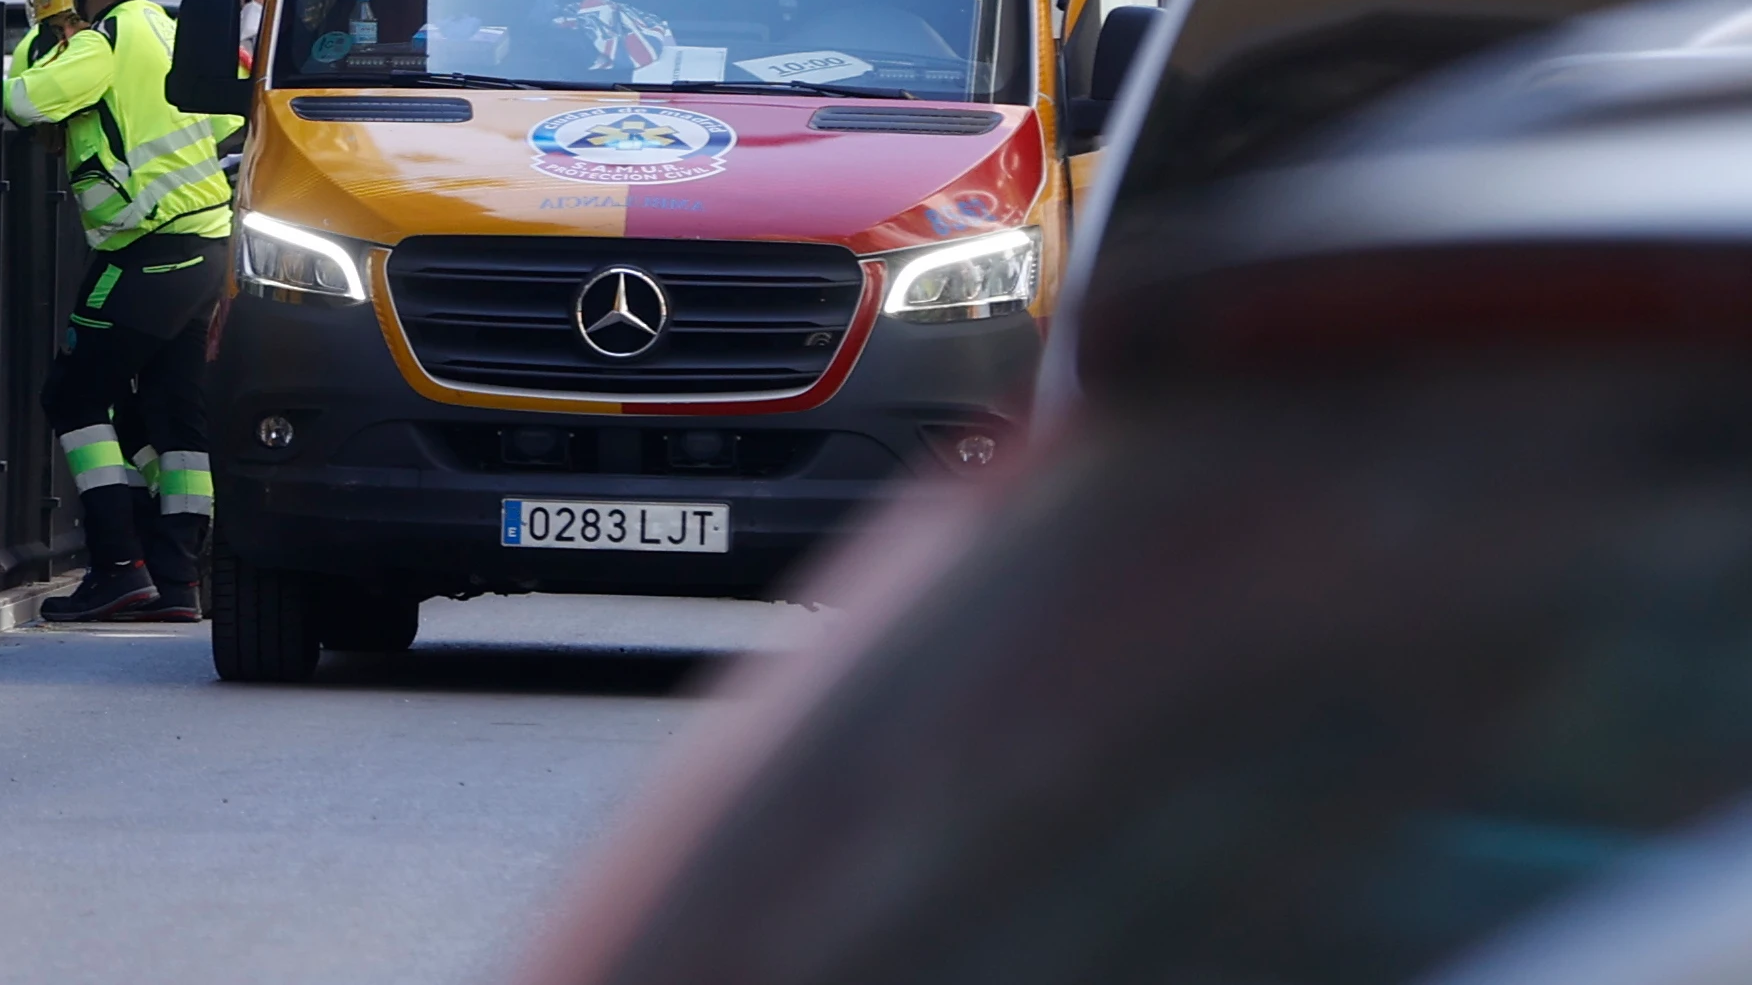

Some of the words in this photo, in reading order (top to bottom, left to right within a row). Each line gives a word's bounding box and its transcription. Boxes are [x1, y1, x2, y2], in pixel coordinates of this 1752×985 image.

[768, 56, 845, 76] 10:00
[543, 107, 607, 131] ciudad
[617, 106, 648, 115] de
[660, 109, 728, 134] madrid
[544, 163, 658, 182] PROTECCION
[664, 165, 710, 180] CIVIL
[571, 162, 684, 175] S.A.M.U.R.
[508, 526, 517, 538] E
[528, 506, 627, 543] 0283
[640, 509, 714, 546] LJT
